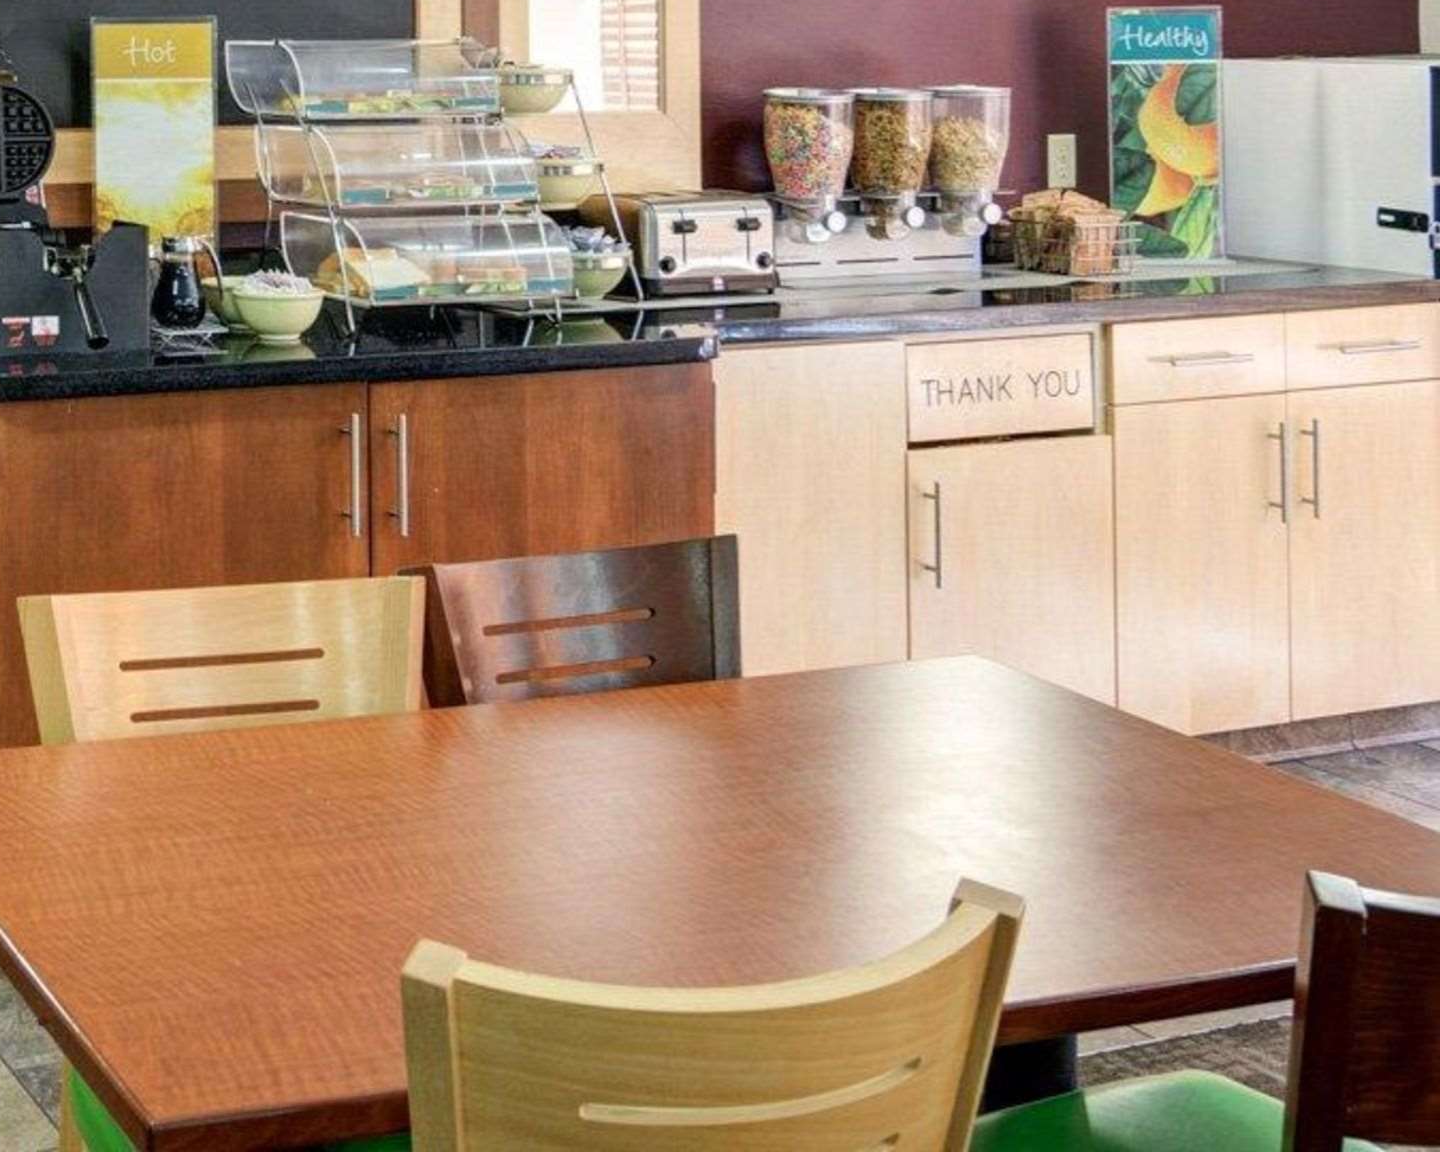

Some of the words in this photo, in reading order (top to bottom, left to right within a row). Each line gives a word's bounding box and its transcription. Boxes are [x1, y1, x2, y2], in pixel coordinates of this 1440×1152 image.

[122, 35, 177, 67] Hot
[1119, 23, 1209, 56] Healthy
[921, 374, 1012, 406] THANK
[1028, 369, 1081, 399] YOU
